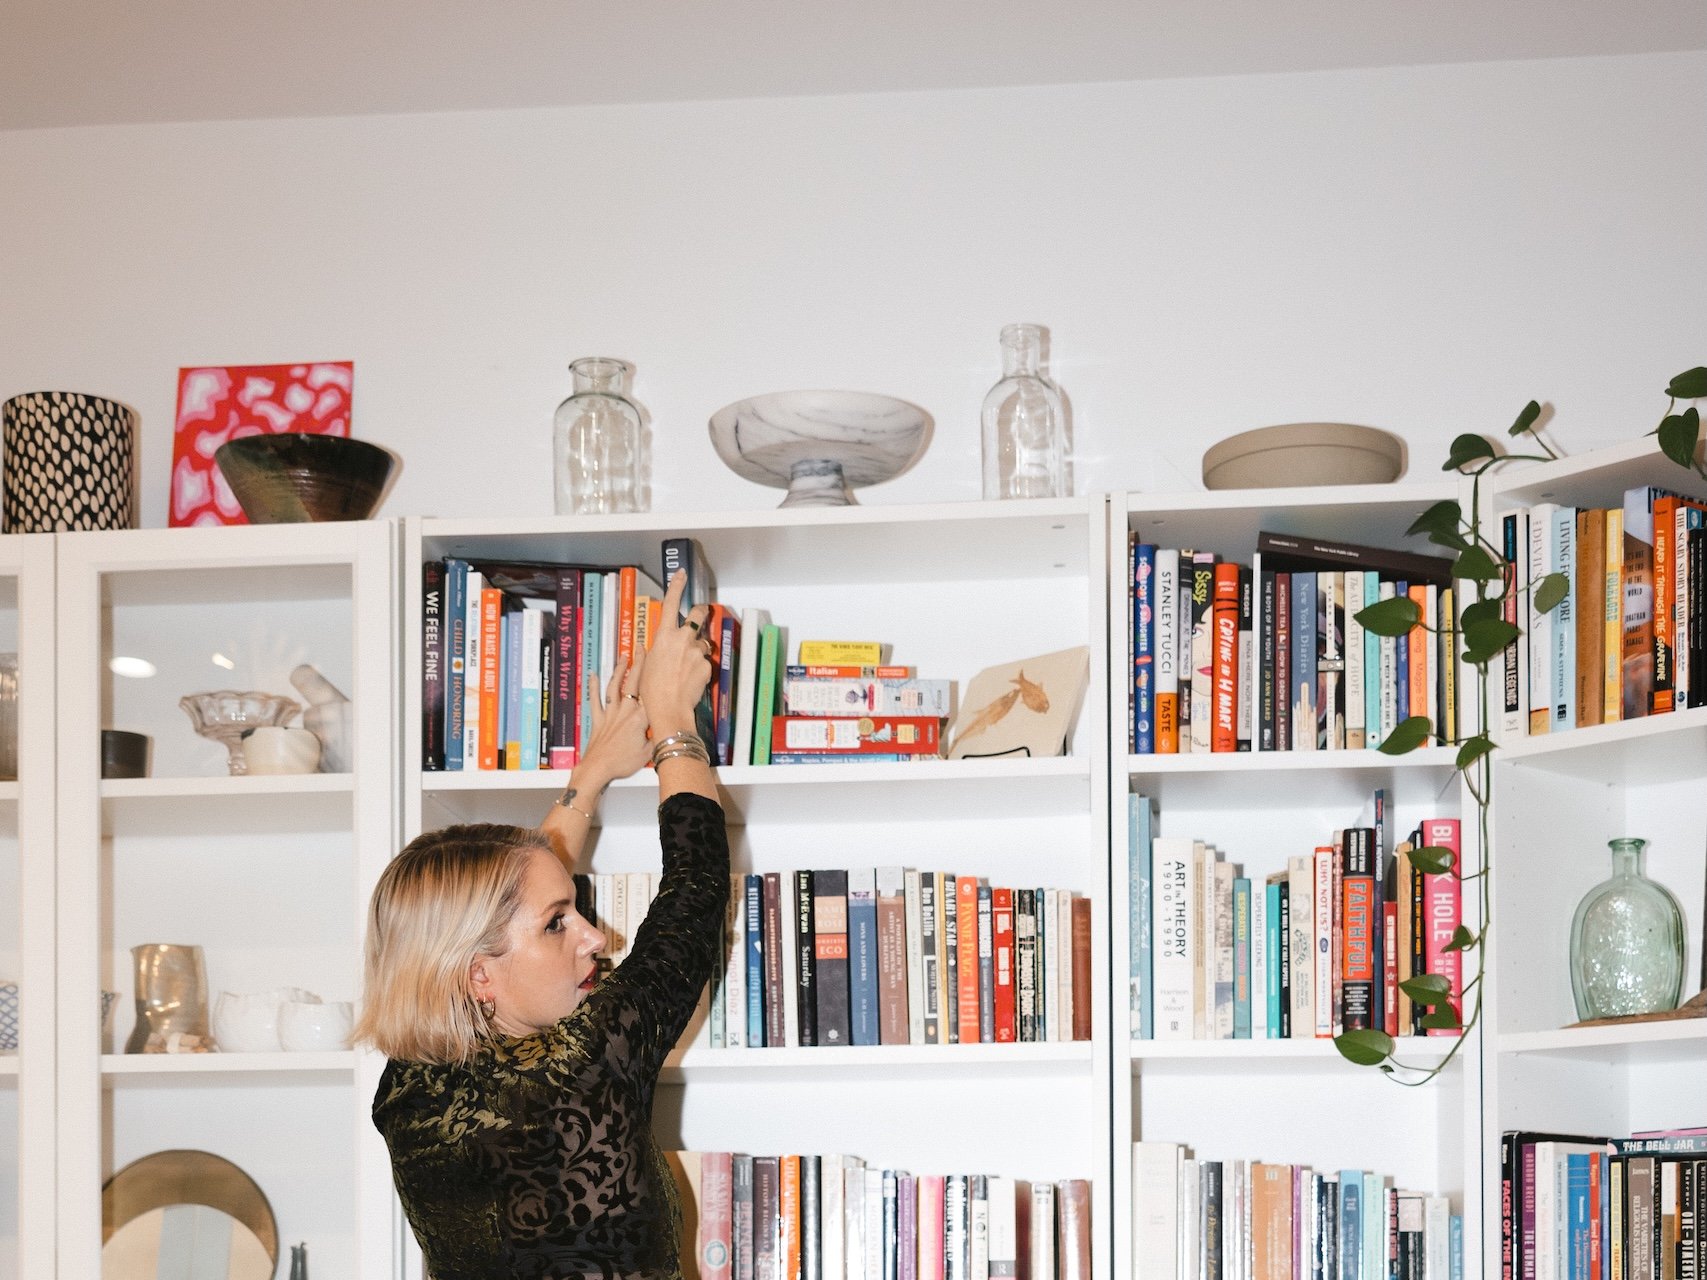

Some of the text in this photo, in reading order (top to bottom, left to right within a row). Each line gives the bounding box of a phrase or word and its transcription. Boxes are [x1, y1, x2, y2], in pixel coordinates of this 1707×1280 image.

[666, 548, 679, 568] OLD
[1656, 537, 1664, 562] HEARD
[1192, 570, 1212, 605] Sissy
[1656, 566, 1664, 574] IT
[1677, 513, 1686, 628] THE SCARY STORY READER
[486, 604, 496, 620] HOW
[1606, 572, 1618, 622] FOLKLORE
[1656, 578, 1664, 614] THROUGH
[426, 592, 439, 681] WE FEEL FINE
[486, 624, 496, 632] TO
[558, 606, 572, 632] Why
[1140, 609, 1148, 652] DAUGHTER
[1162, 572, 1172, 674] STANLEY TUCCI
[1300, 583, 1308, 674] New York Diaries
[1656, 618, 1664, 634] THE
[486, 634, 496, 655] RAISE
[558, 636, 572, 658] She
[1218, 618, 1234, 662] CRYING
[486, 658, 496, 667] AN
[810, 668, 838, 676] Italian
[1656, 636, 1665, 681] GRAPEVINE
[452, 619, 464, 740] CHILD HONORING
[486, 669, 496, 692] ADULT
[558, 662, 572, 700] Wrote
[1218, 678, 1234, 690] H
[1162, 700, 1172, 733] TASTE
[1218, 692, 1234, 731] MART
[1175, 861, 1186, 888] ART
[1432, 825, 1454, 942] BLK HOLE
[748, 888, 759, 932] NETHERLAND
[923, 888, 932, 936] Don DeLillo
[946, 881, 956, 946] BINARY STAR
[800, 873, 811, 988] Ian McEwan Saturday
[962, 902, 974, 976] FANNIE FLAGG
[1175, 901, 1186, 958] THEORY
[1348, 882, 1366, 978] FAITHFUL
[820, 946, 843, 955] ECO
[1020, 947, 1034, 989] JURASSIC
[1622, 1139, 1694, 1152] THE BELL JAR
[1502, 1180, 1511, 1217] FACES
[741, 1202, 752, 1263] DENYING
[1503, 1219, 1511, 1234] OF
[1525, 1230, 1534, 1245] THE
[1503, 1238, 1511, 1260] THE
[1525, 1249, 1534, 1278] HUMAN
